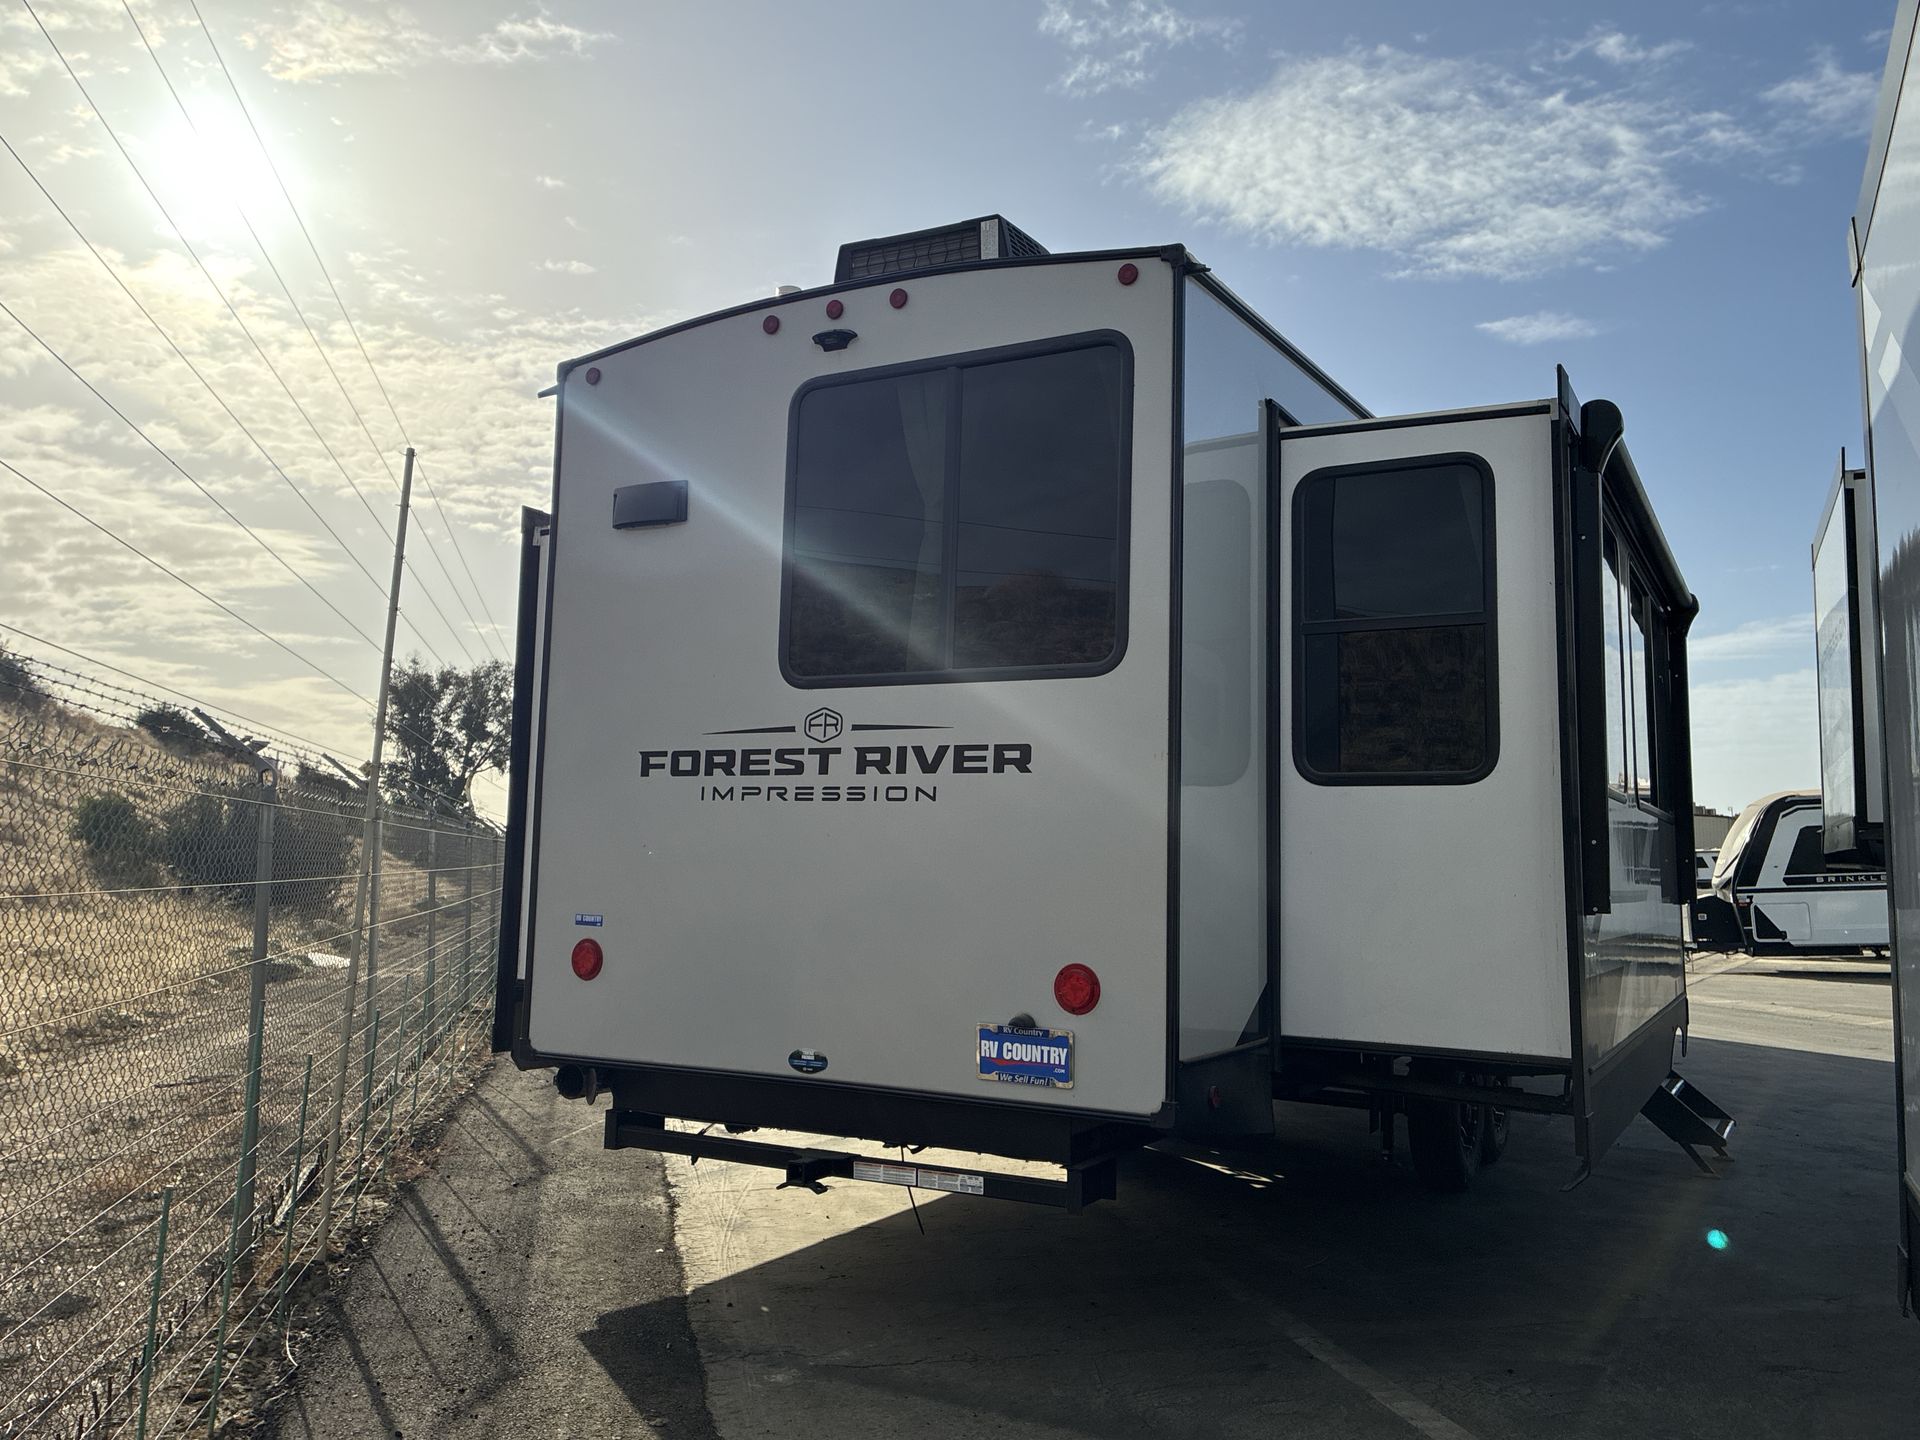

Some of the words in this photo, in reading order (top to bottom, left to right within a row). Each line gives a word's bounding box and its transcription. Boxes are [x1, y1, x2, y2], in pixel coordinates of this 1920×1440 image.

[639, 747, 841, 777] FOREST
[854, 743, 1033, 775] RIVER
[700, 786, 937, 802] IMPRESSION
[1013, 1027, 1044, 1037] Country
[980, 1039, 999, 1058] RV
[1002, 1042, 1068, 1066] COUNTRY
[1000, 1073, 1013, 1082] We
[1014, 1074, 1029, 1084] Sell
[1030, 1076, 1048, 1086] Fun!
